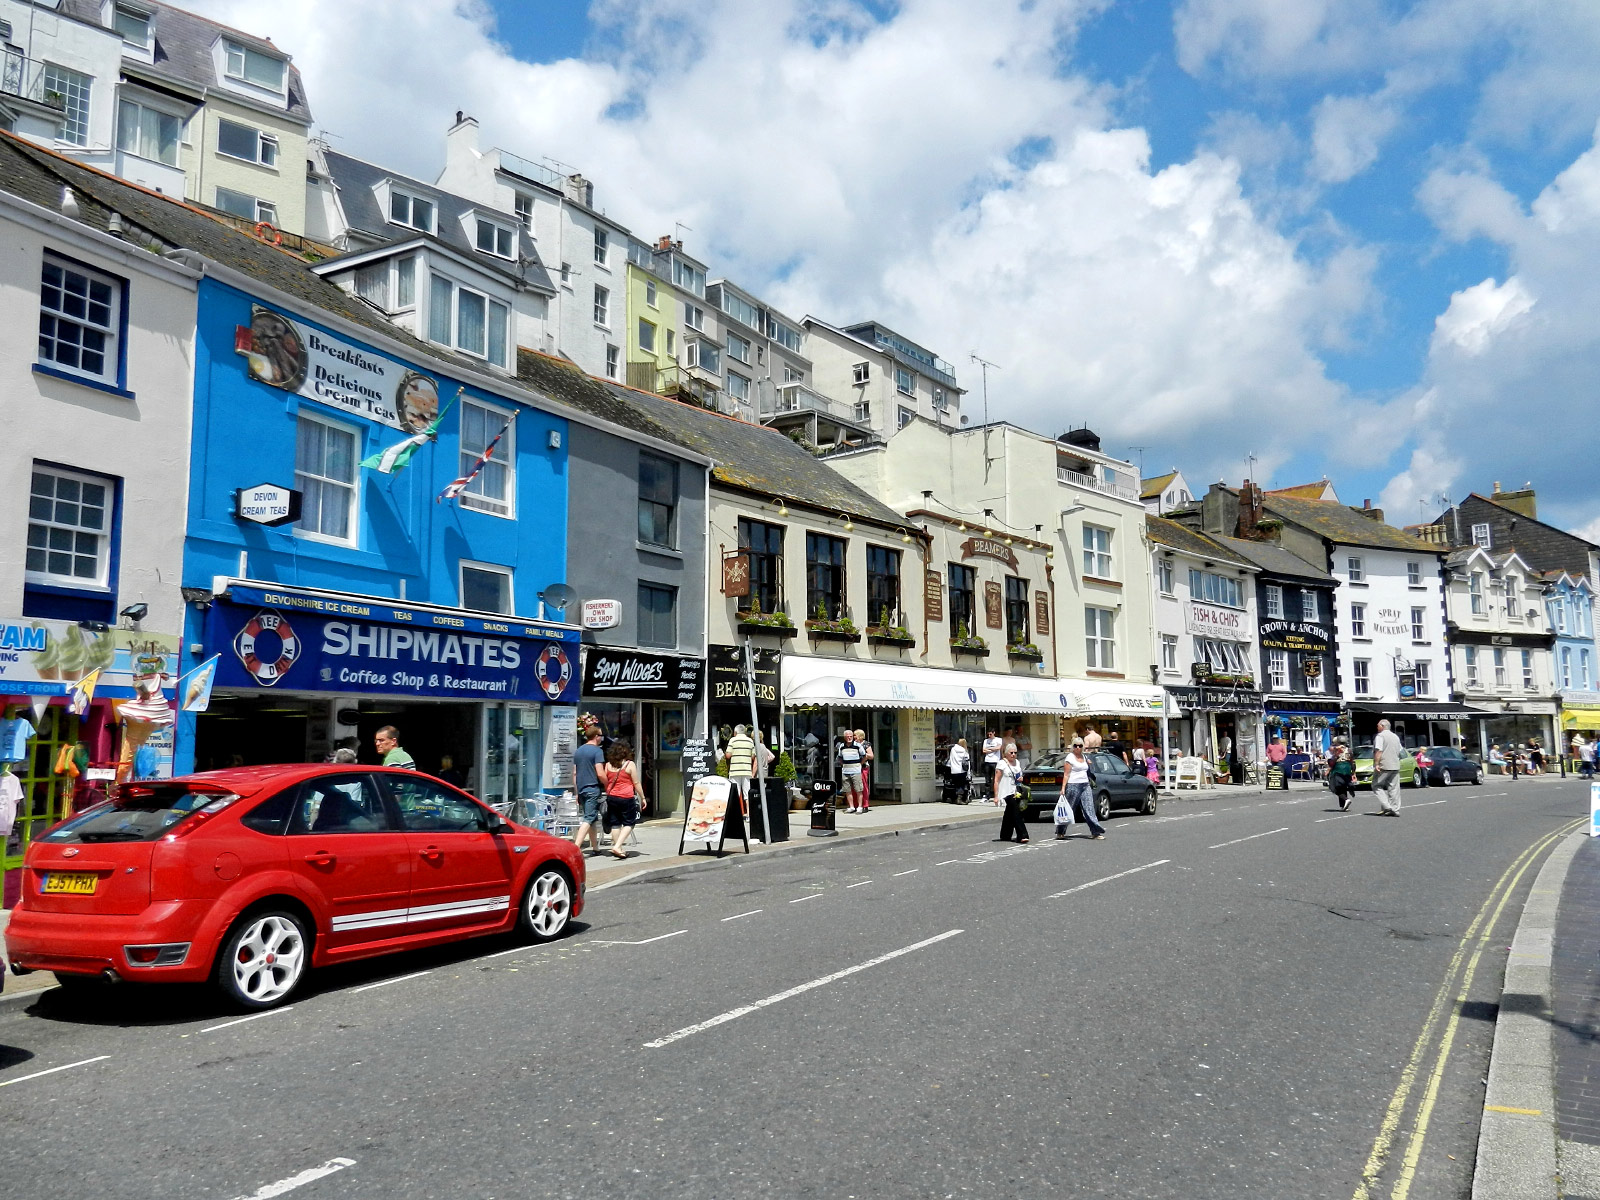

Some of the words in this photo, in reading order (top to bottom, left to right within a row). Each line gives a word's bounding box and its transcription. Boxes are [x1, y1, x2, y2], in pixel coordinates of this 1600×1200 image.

[309, 334, 385, 376] Breakfasts
[315, 365, 383, 400] Delicious
[315, 381, 361, 409] Cream
[365, 399, 396, 420] Teas
[254, 492, 278, 502] DEVON
[241, 506, 267, 516] CREAM
[270, 506, 287, 515] TEAS
[974, 540, 1010, 560] BEAMERS
[264, 593, 324, 610] DEVONSHIRE
[325, 602, 339, 612] ICE
[341, 604, 370, 616] CREAM
[393, 610, 413, 621] TEAS
[433, 616, 465, 627] COFFEES
[483, 622, 509, 632] SNACKS
[525, 627, 545, 637] FAMILY
[545, 630, 564, 639] MEALS
[1193, 607, 1210, 622] FISH
[1211, 610, 1218, 623] &
[1219, 612, 1239, 627] CHIPS
[1378, 608, 1401, 618] SPRAT
[0, 624, 46, 651] AM
[1260, 621, 1288, 635] CROWN
[1290, 622, 1297, 632] &
[1297, 623, 1329, 642] ANCHOR
[1373, 622, 1409, 635] MACKEREL
[322, 621, 521, 669] SHIPMATES
[340, 667, 388, 685] Coffee
[392, 671, 425, 691] Shop
[428, 673, 439, 687] &
[443, 674, 508, 692] Restaurant
[593, 657, 621, 686] SAM
[621, 658, 664, 682] WIDGES
[28, 684, 60, 693] FROM
[1206, 692, 1217, 702] The
[1119, 698, 1145, 709] FUDGE
[46, 874, 73, 890] EJ57
[73, 875, 97, 890] PHX
